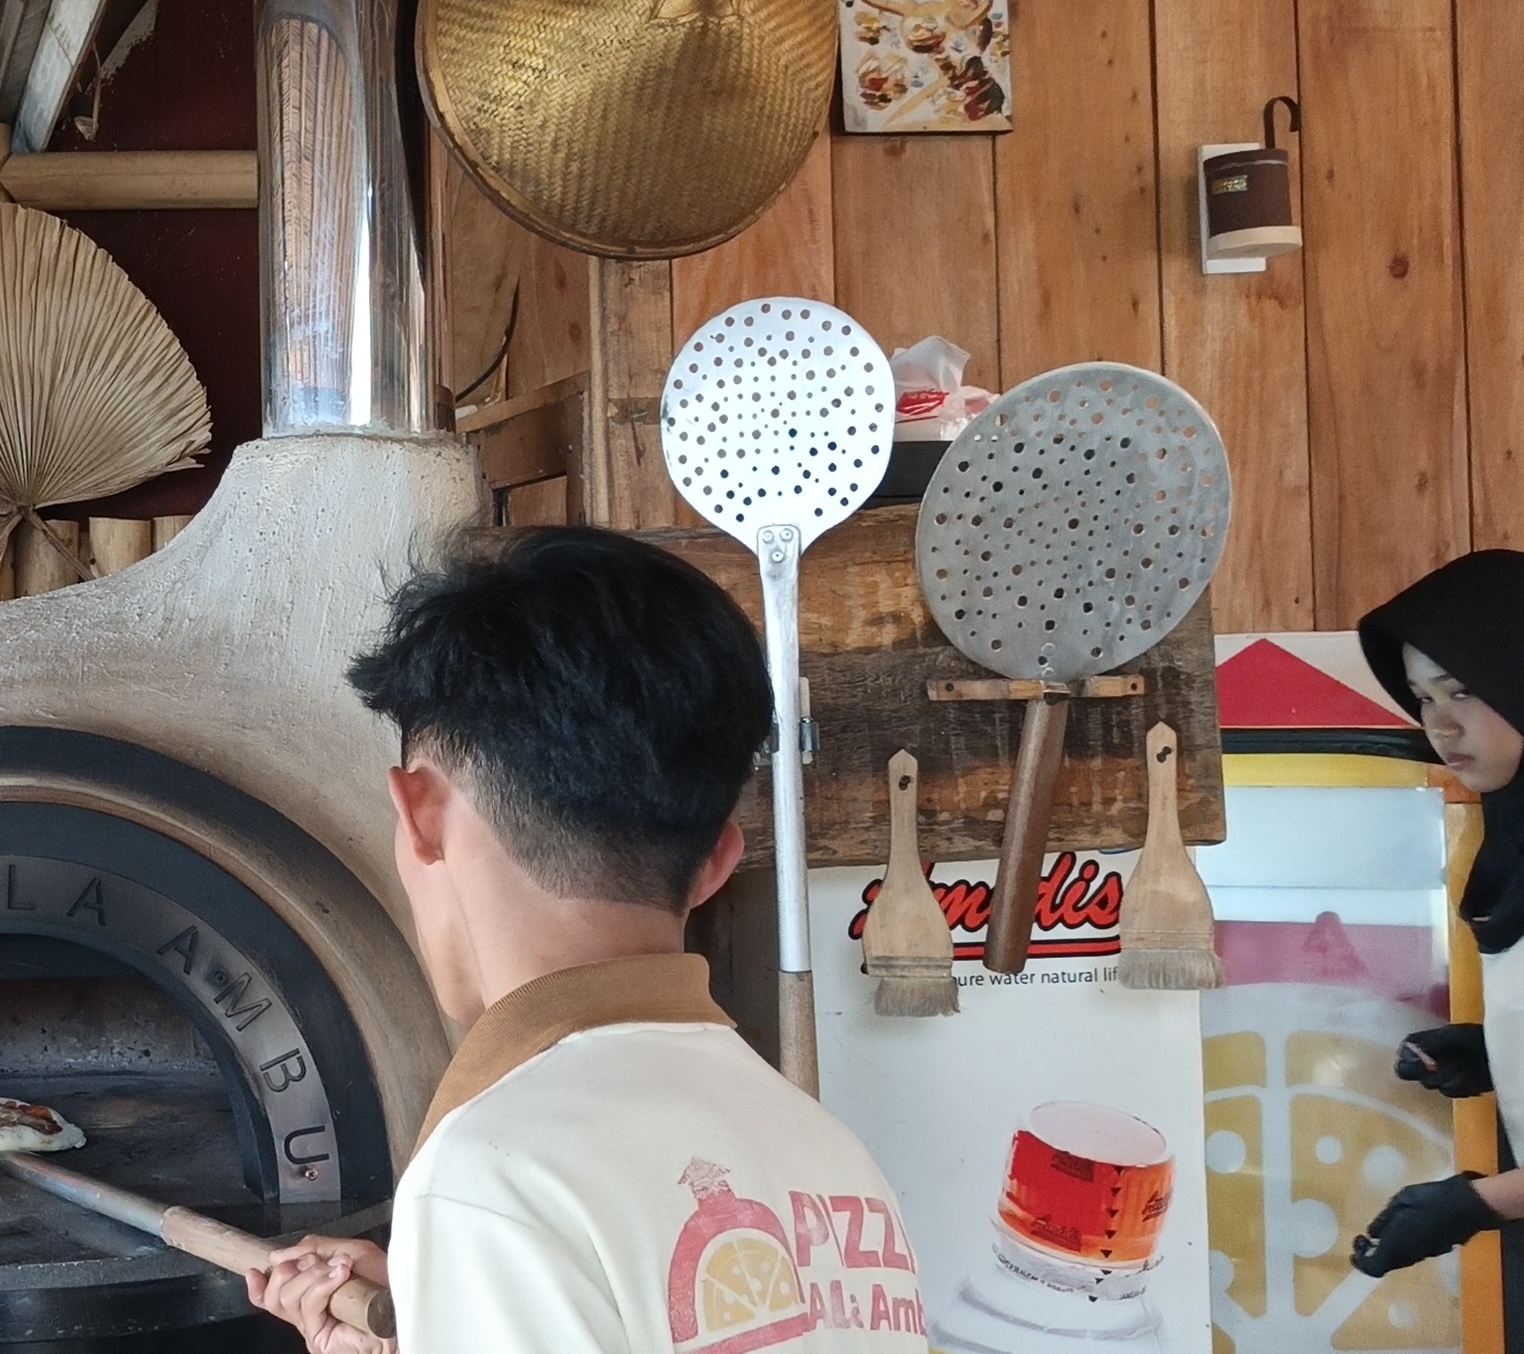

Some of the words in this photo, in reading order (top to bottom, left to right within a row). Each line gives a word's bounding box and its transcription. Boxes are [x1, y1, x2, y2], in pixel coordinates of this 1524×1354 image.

[989, 973, 1035, 986] water
[1041, 967, 1098, 983] natural
[1103, 967, 1119, 982] lif
[156, 925, 330, 1165] AMBU
[788, 1190, 916, 1274] PIZZ
